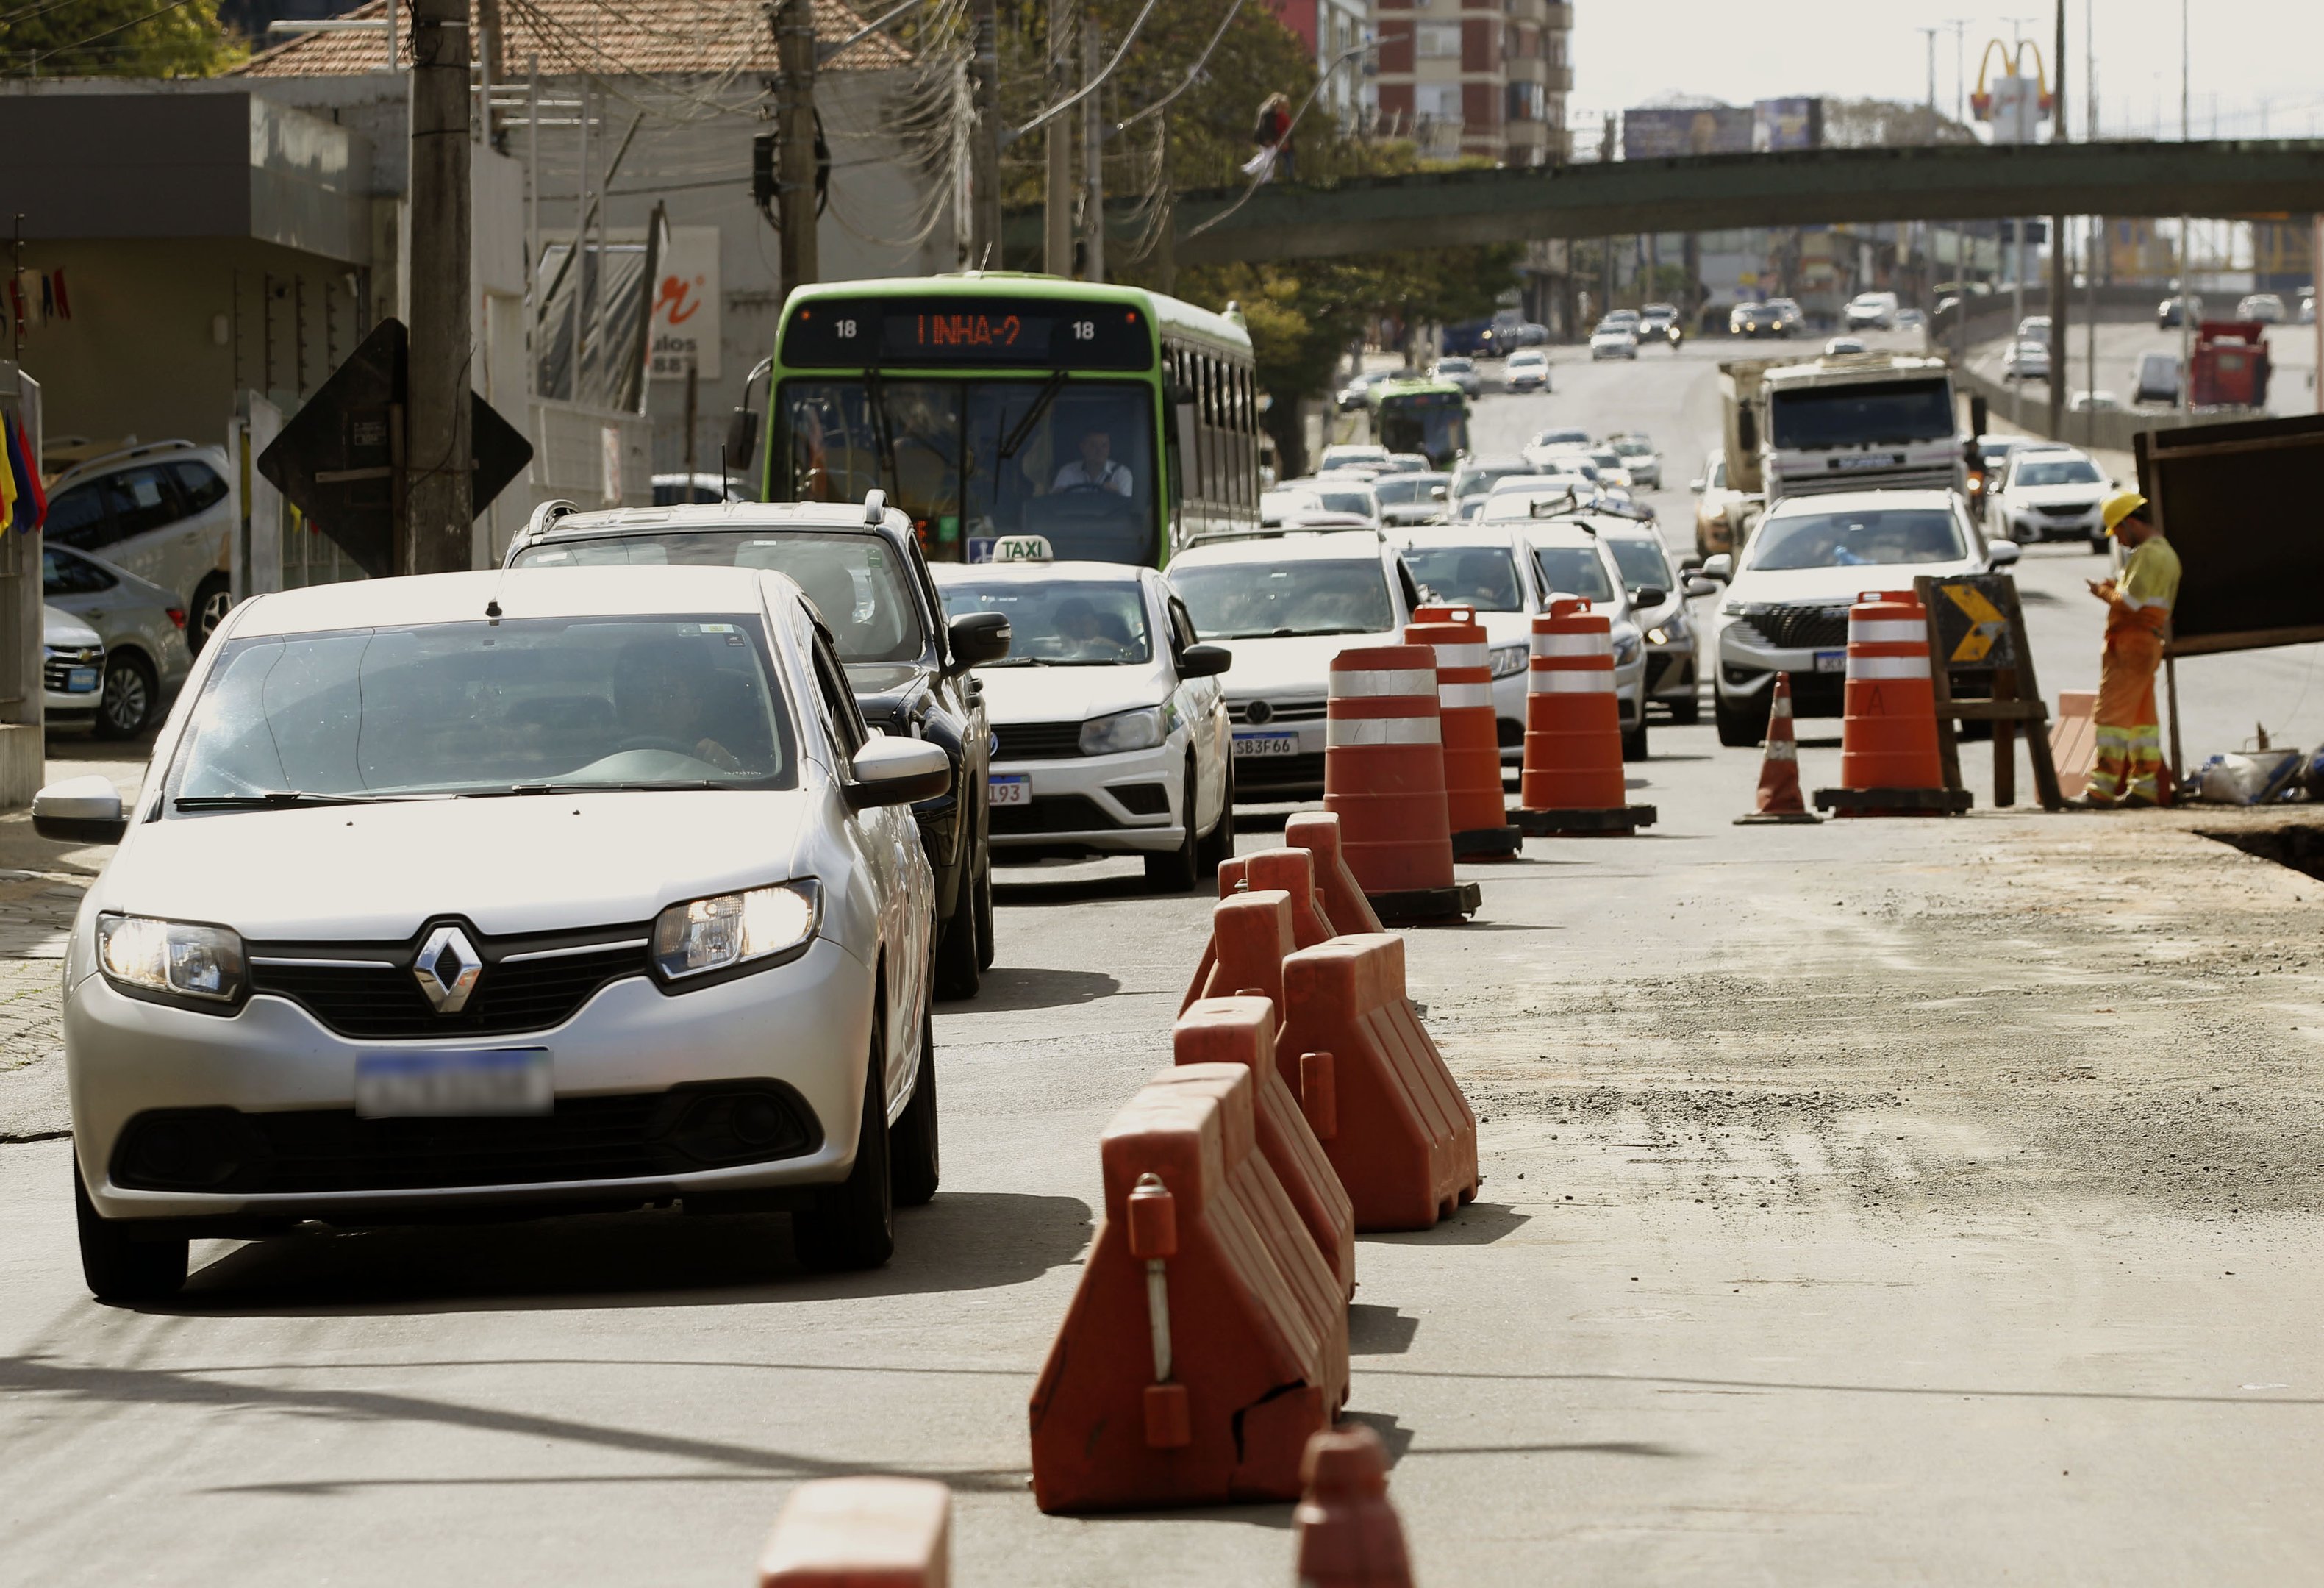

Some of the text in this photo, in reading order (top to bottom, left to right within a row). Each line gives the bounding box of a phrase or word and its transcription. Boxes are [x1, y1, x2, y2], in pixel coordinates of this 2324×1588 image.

[834, 319, 857, 339] 18
[1072, 321, 1095, 340] 18
[1001, 540, 1043, 558] TAXI
[1234, 738, 1290, 754] SB3F66
